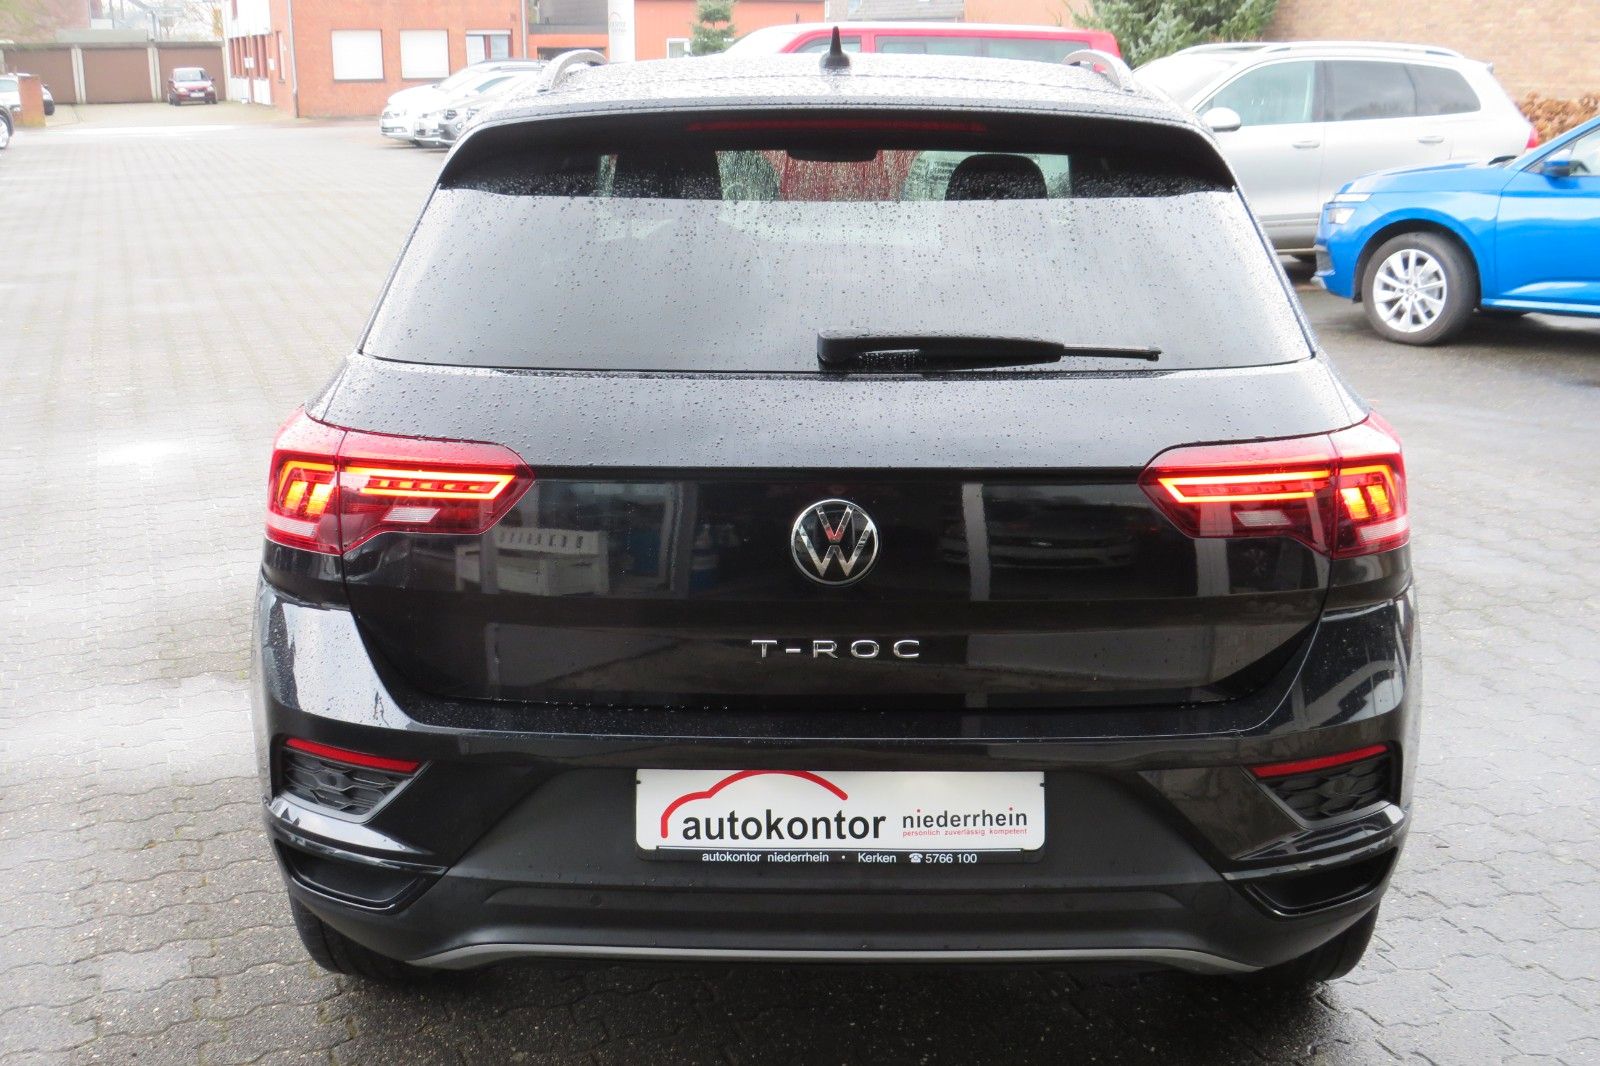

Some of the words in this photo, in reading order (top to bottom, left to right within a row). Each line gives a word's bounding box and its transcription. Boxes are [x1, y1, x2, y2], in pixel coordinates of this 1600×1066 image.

[751, 639, 920, 659] T-ROC
[682, 809, 887, 840] autokontor
[902, 807, 1028, 829] niederrhein
[989, 828, 1028, 836] kompetent
[702, 852, 761, 862] autokontor
[767, 852, 829, 863] niederrhein
[857, 852, 897, 863] Kerken
[925, 853, 954, 863] 5766
[957, 853, 978, 863] 100
